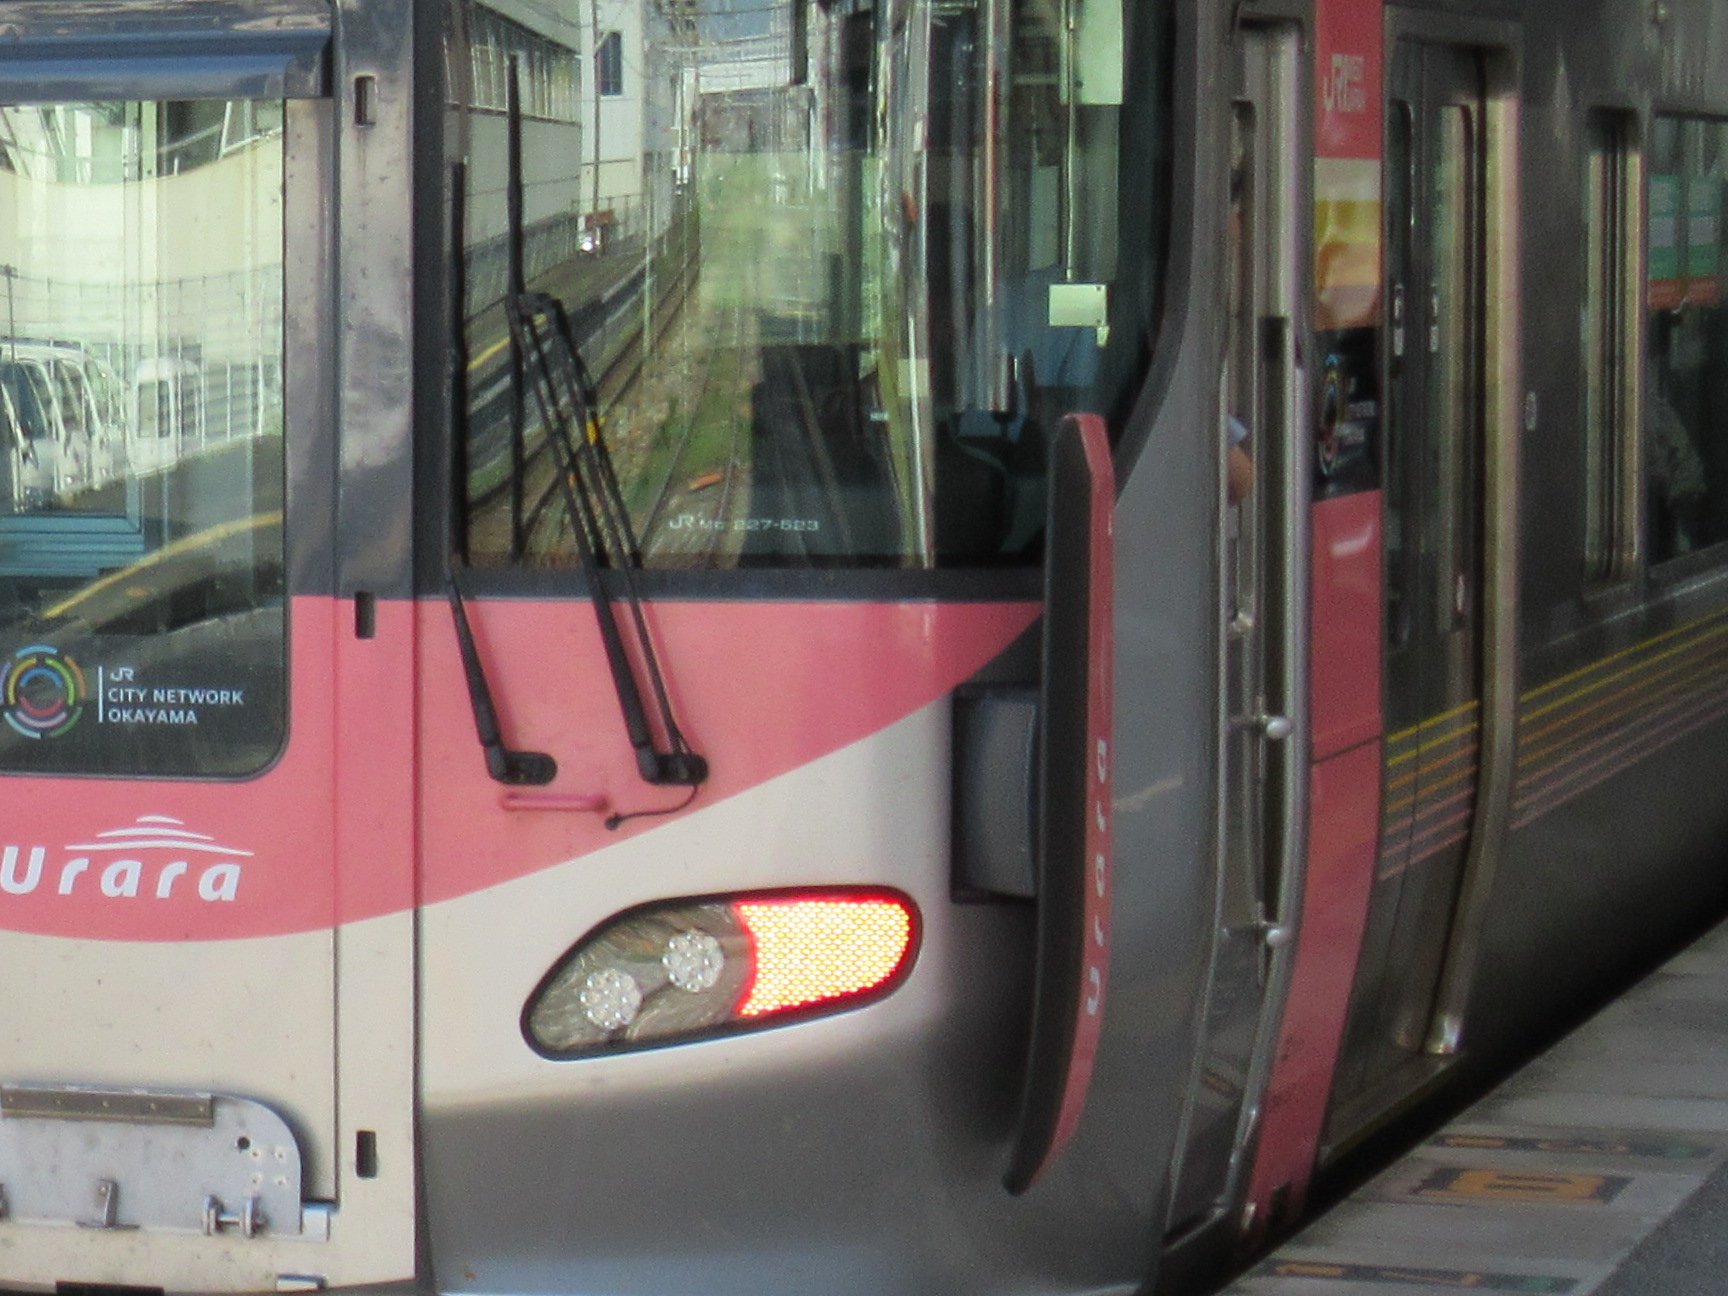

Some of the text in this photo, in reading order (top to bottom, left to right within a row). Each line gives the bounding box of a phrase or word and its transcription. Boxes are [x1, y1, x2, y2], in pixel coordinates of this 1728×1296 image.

[669, 512, 694, 530] JR
[109, 667, 134, 683] JR
[107, 688, 243, 705] CITY NETWORK
[107, 708, 198, 725] OKAYAMA
